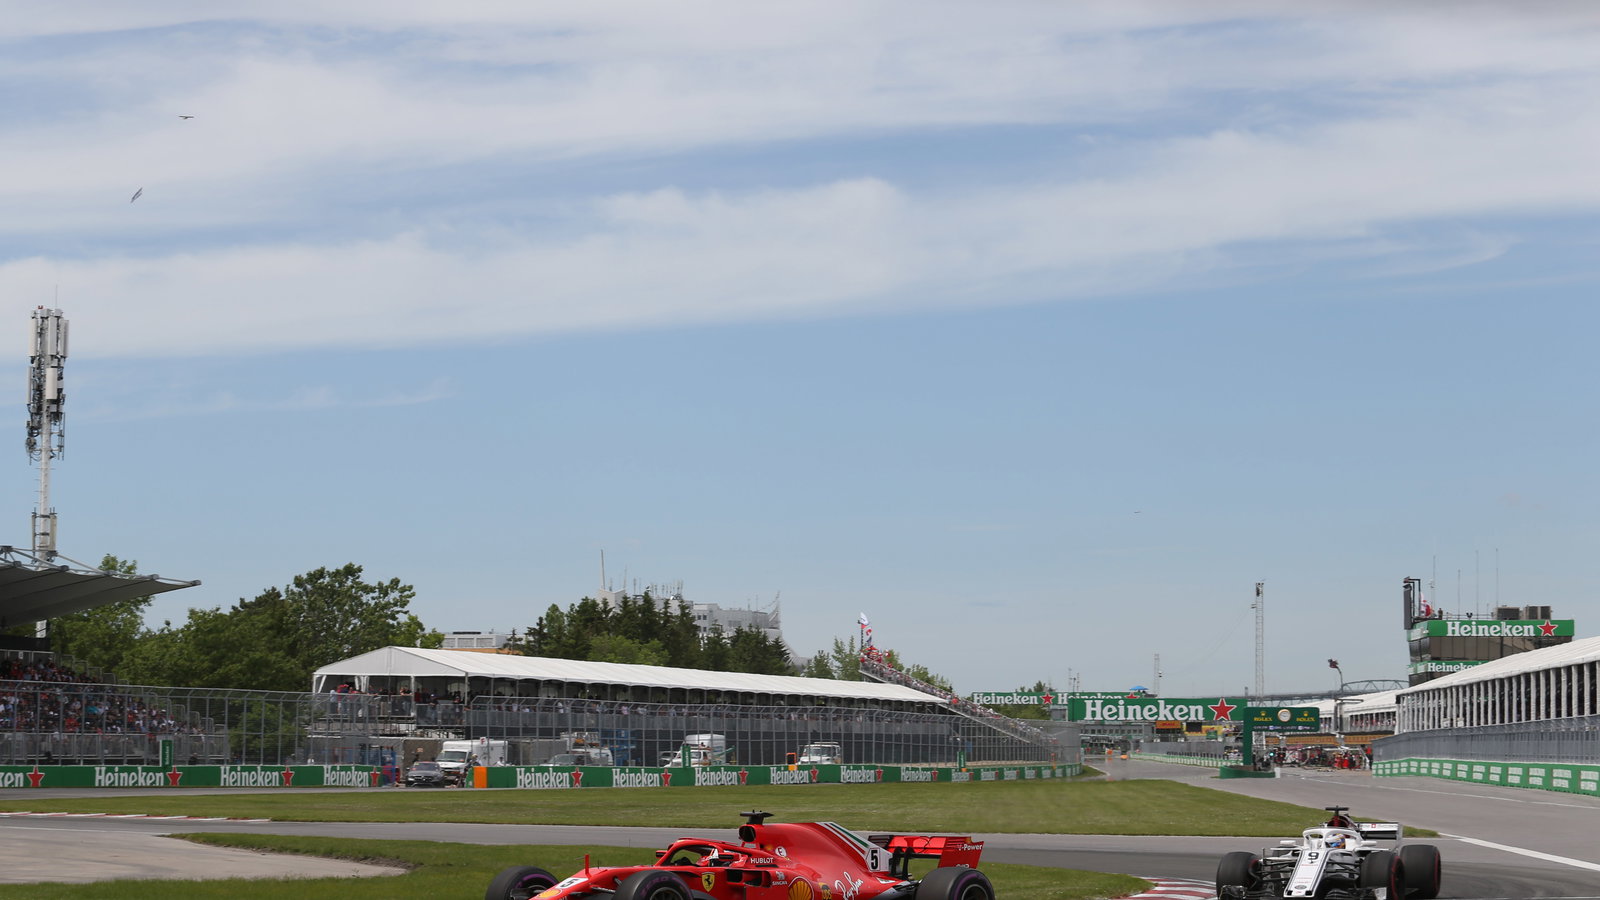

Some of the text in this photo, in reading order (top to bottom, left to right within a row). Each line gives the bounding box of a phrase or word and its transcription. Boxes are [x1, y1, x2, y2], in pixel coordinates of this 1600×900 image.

[1446, 621, 1535, 637] Heineken
[1427, 662, 1475, 672] Heineke
[972, 693, 1038, 705] Heineken
[1083, 700, 1206, 721] Heineken
[95, 766, 164, 787] Heineken
[220, 766, 280, 787] Heineken
[323, 766, 369, 787] Heineken
[516, 767, 570, 788] Heineken
[612, 768, 660, 787] Heineken
[694, 767, 738, 786] Heineken
[770, 767, 809, 785] Heineken
[840, 766, 875, 784] Heineken
[901, 767, 931, 782] Heineken
[870, 850, 879, 870] 5
[1308, 852, 1320, 861] 9
